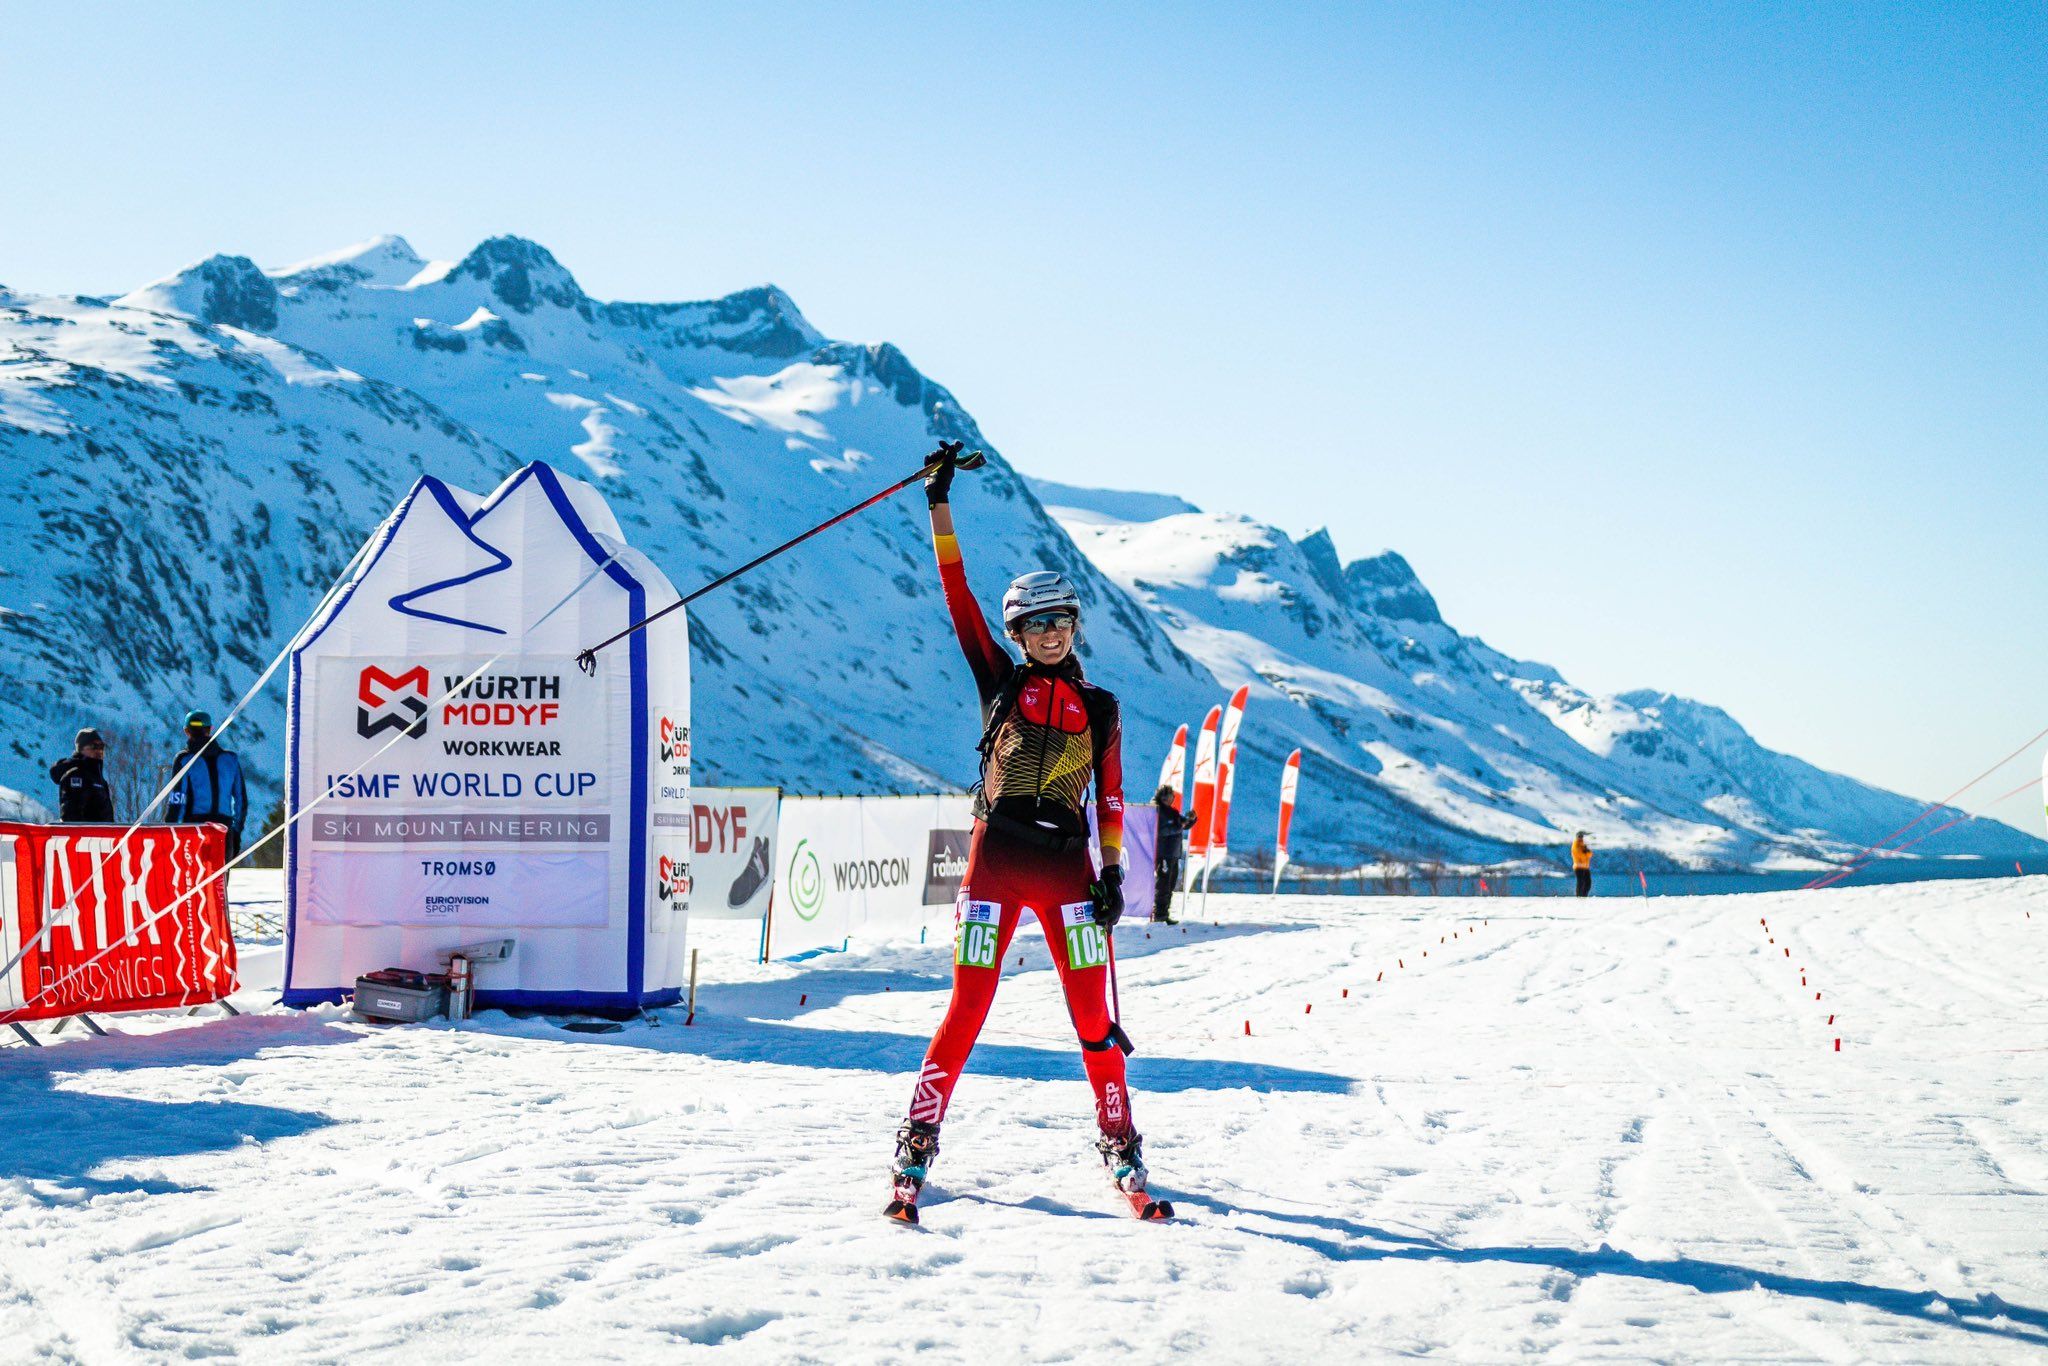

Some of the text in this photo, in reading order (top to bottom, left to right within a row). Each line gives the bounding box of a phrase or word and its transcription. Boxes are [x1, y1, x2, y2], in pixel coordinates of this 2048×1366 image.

[444, 676, 560, 699] WÜRTH
[443, 703, 560, 726] MODYF
[443, 740, 562, 756] WORKWEAR
[327, 772, 596, 798] ISMF WORLD CUP
[324, 821, 598, 836] SKI MOUNTAINEERING
[689, 804, 747, 853] DYF
[421, 861, 496, 876] TROMSØ
[833, 857, 910, 892] WOODCON
[40, 836, 162, 952] ATK
[425, 904, 460, 913] SPORT
[959, 924, 997, 965] 105
[1068, 925, 1106, 966] 105
[40, 956, 166, 1008] BINDINGS
[1106, 1082, 1121, 1120] ESP
